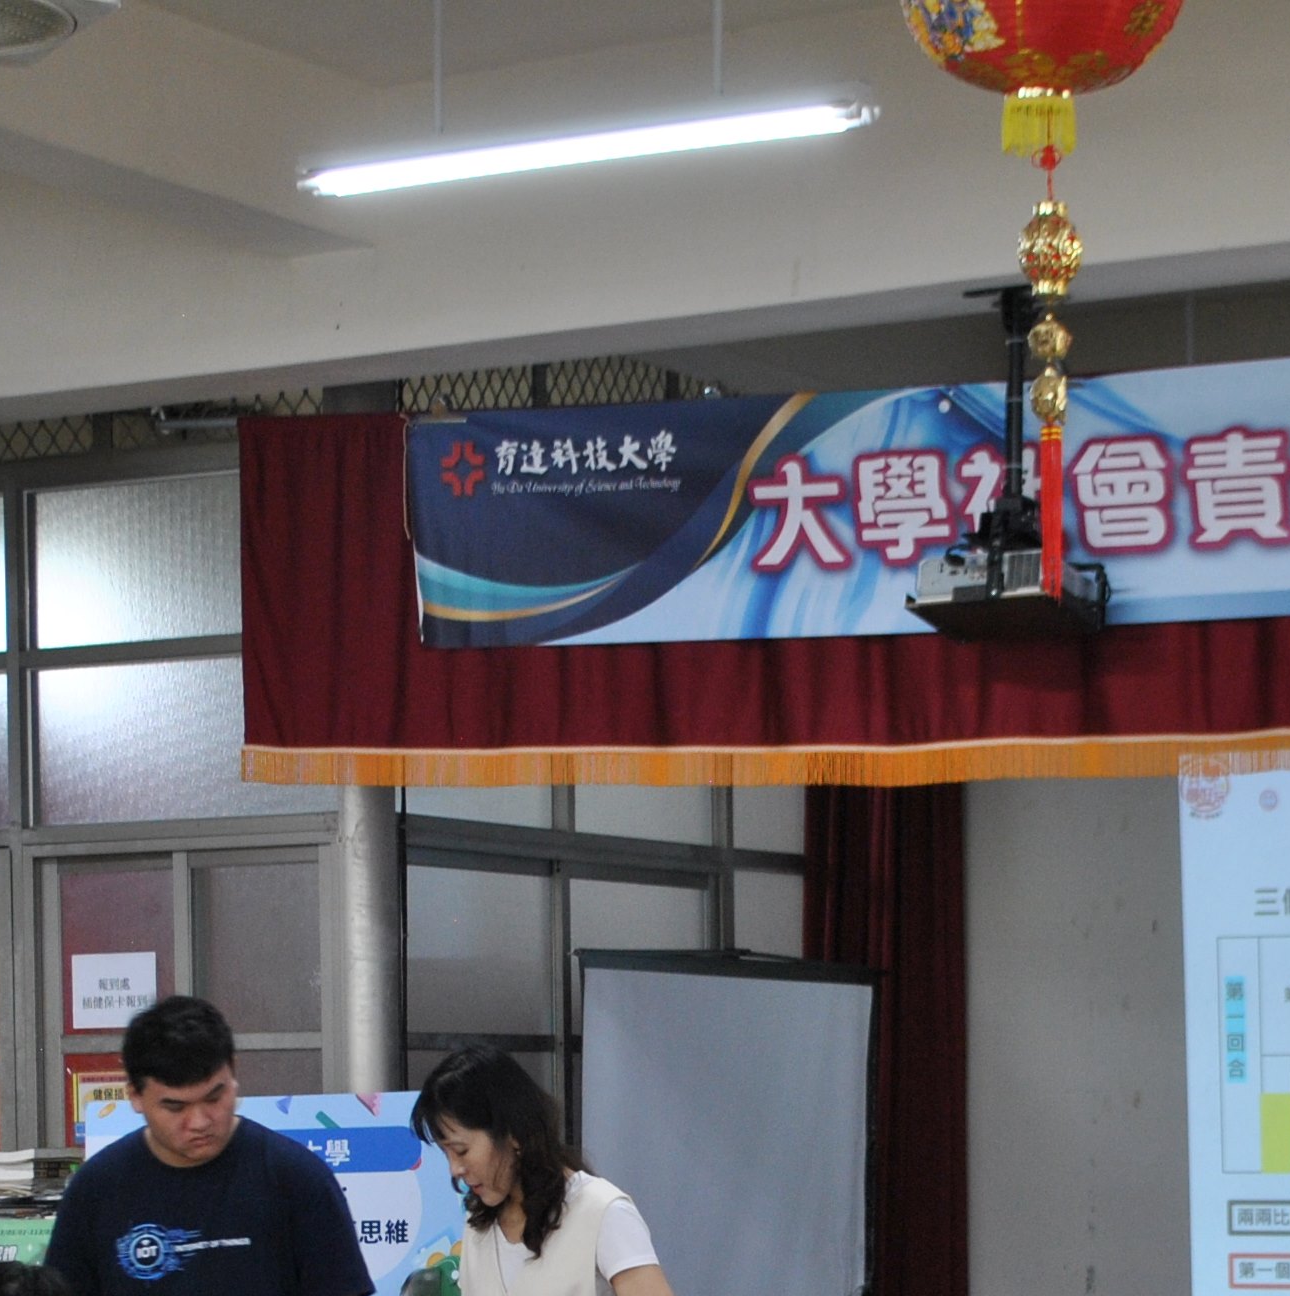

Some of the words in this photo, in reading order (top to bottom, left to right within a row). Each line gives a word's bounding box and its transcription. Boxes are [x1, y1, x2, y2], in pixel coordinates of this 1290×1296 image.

[495, 430, 677, 476] 育達科技大學
[525, 480, 575, 496] University
[574, 479, 585, 496] of
[585, 477, 616, 493] Science
[618, 478, 633, 491] and
[634, 475, 681, 493] Technology
[1225, 981, 1246, 1081] 第一回合
[354, 1219, 409, 1244] 思維
